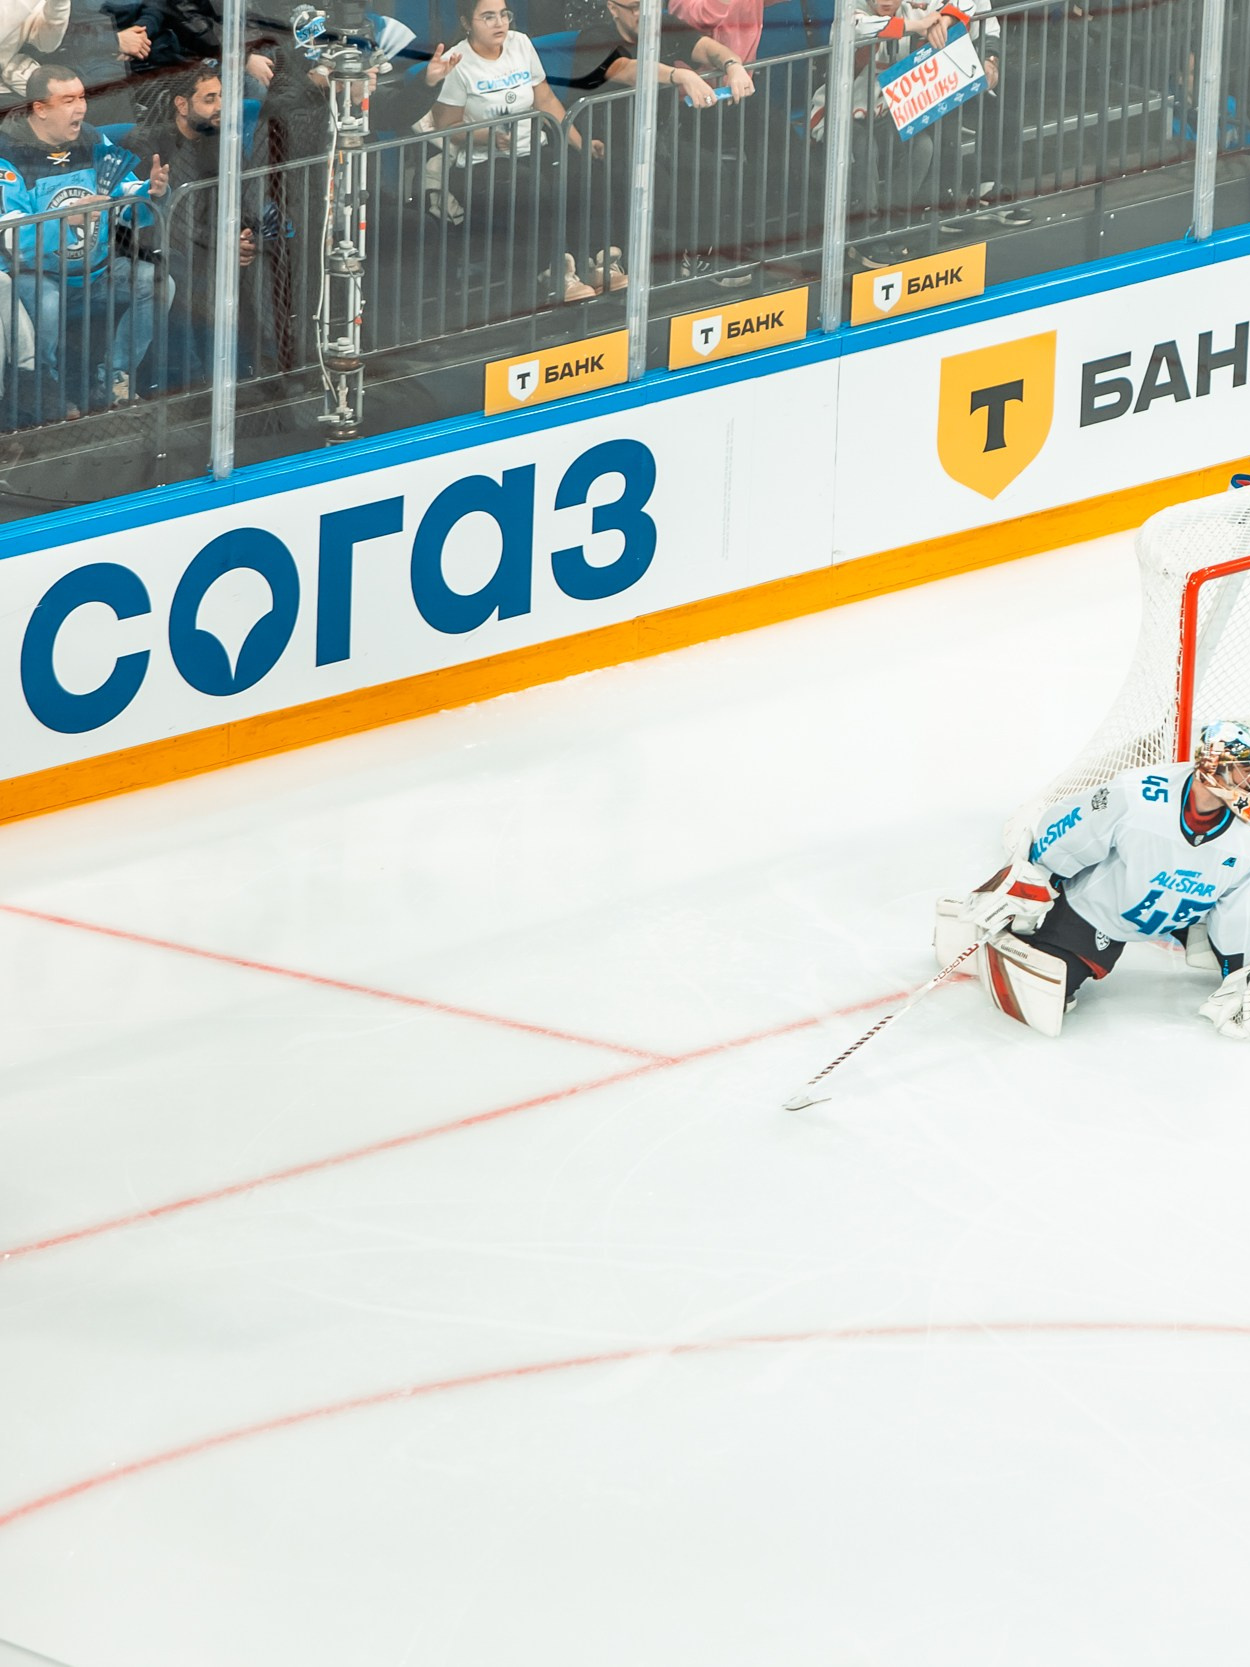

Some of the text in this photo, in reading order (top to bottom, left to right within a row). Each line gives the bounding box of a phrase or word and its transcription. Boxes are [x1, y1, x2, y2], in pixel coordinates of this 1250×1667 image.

[885, 56, 939, 109] ХОЧУ
[907, 266, 963, 295] БАНК
[726, 309, 785, 339] БАНК
[544, 353, 605, 384] БАНК
[1141, 775, 1169, 803] 45
